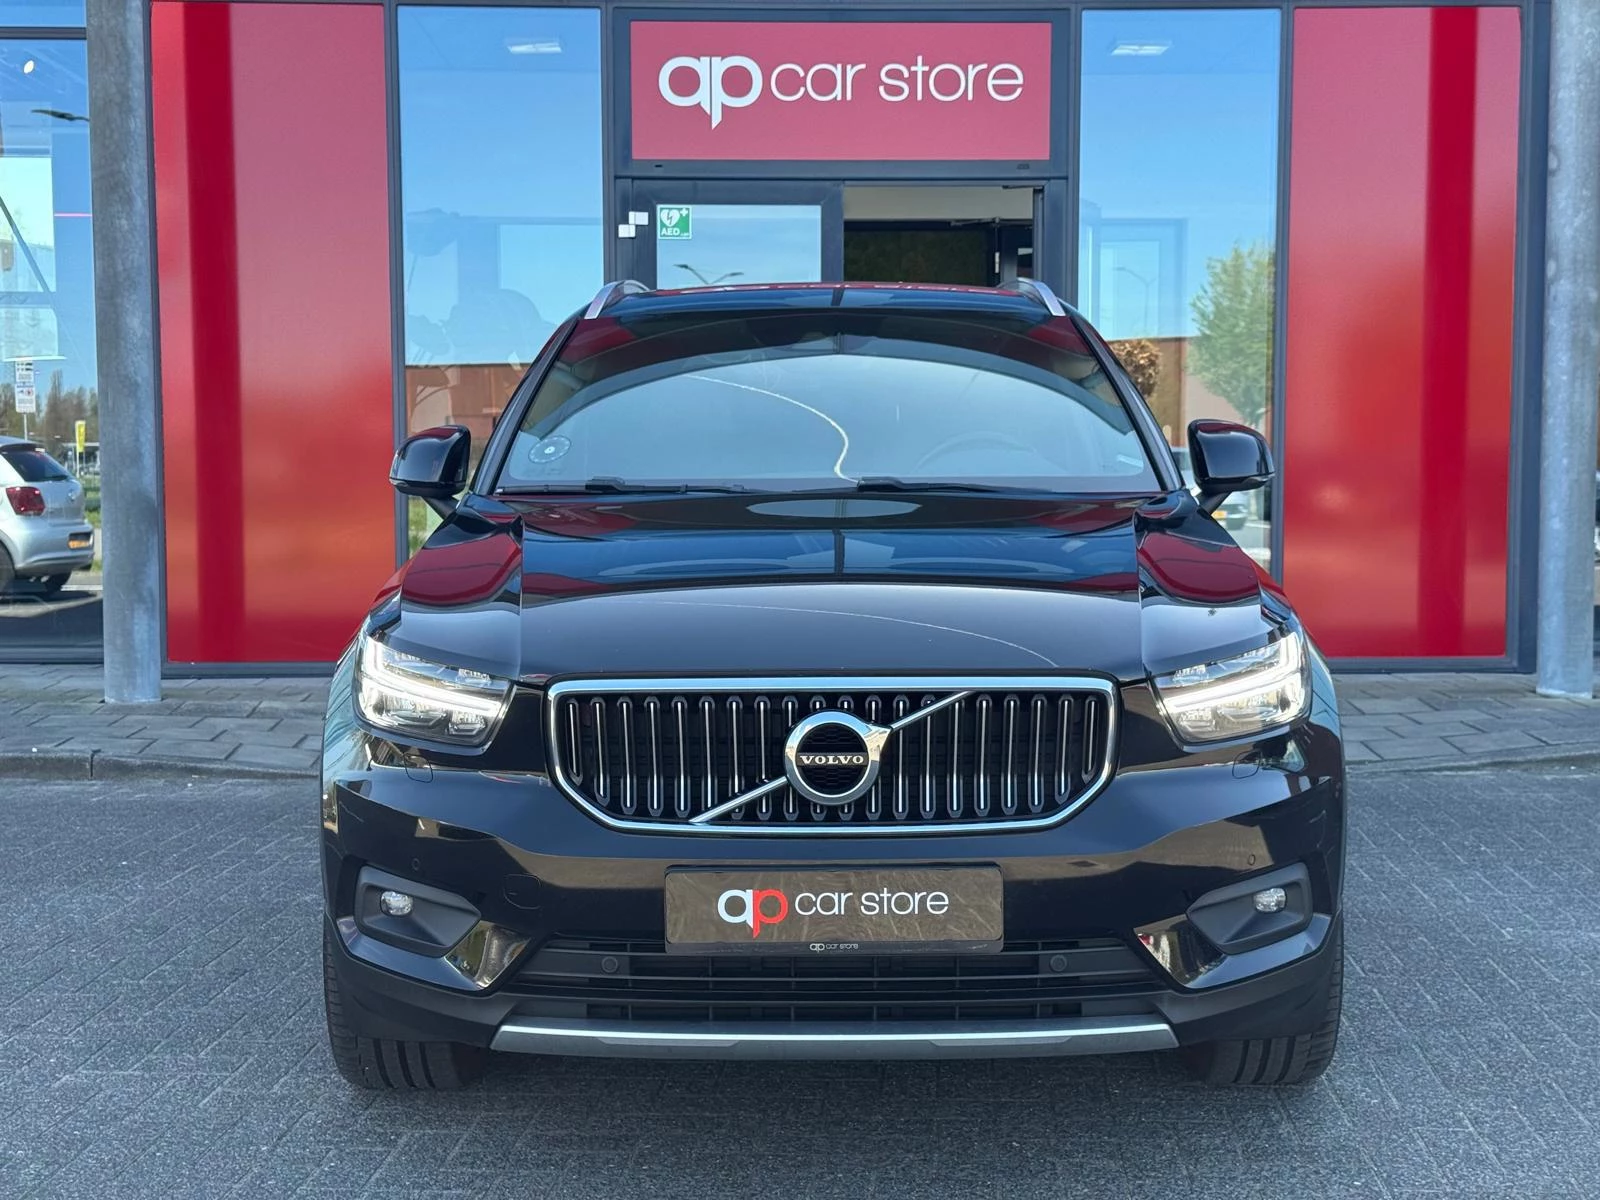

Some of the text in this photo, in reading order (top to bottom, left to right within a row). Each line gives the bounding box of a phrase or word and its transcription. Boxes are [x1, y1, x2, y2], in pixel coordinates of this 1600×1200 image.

[658, 55, 1024, 130] ap car store
[661, 227, 680, 236] AED
[799, 754, 864, 764] VOLVO
[717, 887, 949, 938] ap car store
